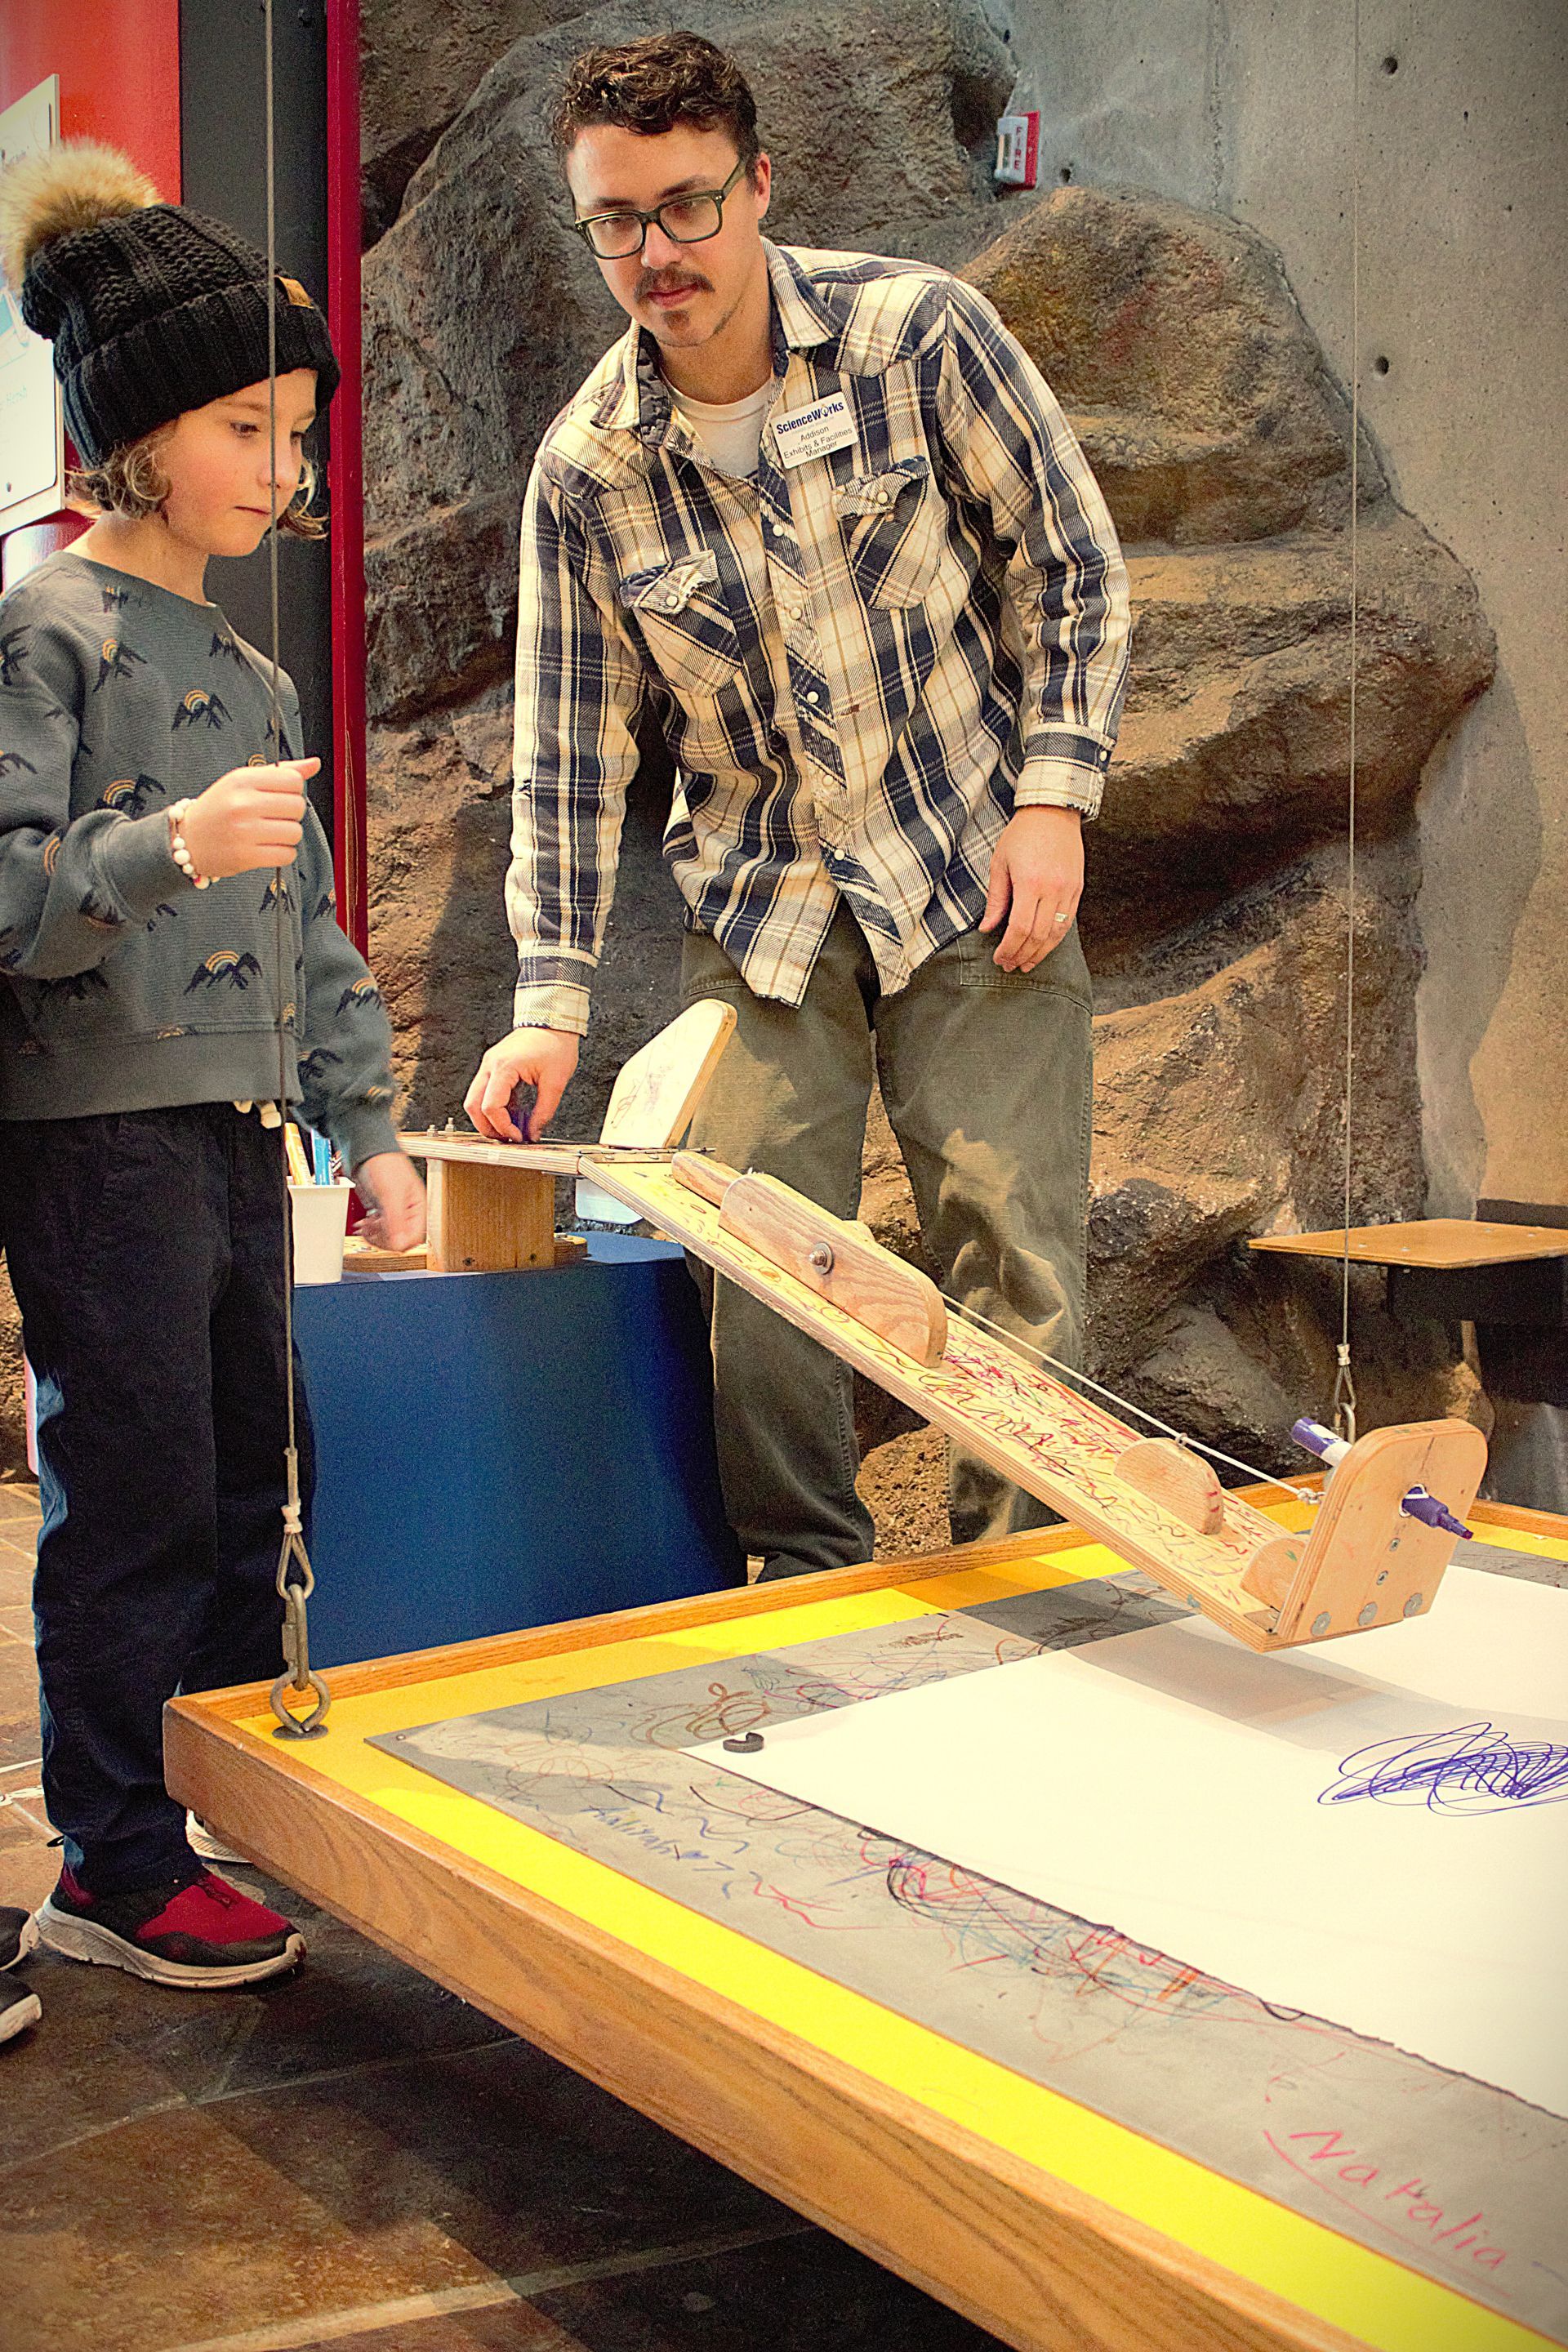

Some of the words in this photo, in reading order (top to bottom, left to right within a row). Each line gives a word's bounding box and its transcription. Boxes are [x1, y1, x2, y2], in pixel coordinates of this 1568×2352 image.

[1014, 127, 1022, 170] FIRE
[776, 401, 844, 434] ScienceWorks
[800, 425, 830, 442] Addison
[784, 443, 813, 459] Exhibits
[813, 439, 820, 448] &
[820, 427, 853, 443] Facilities
[805, 440, 838, 458] Manager
[1288, 2129, 1507, 2270] Natalia
